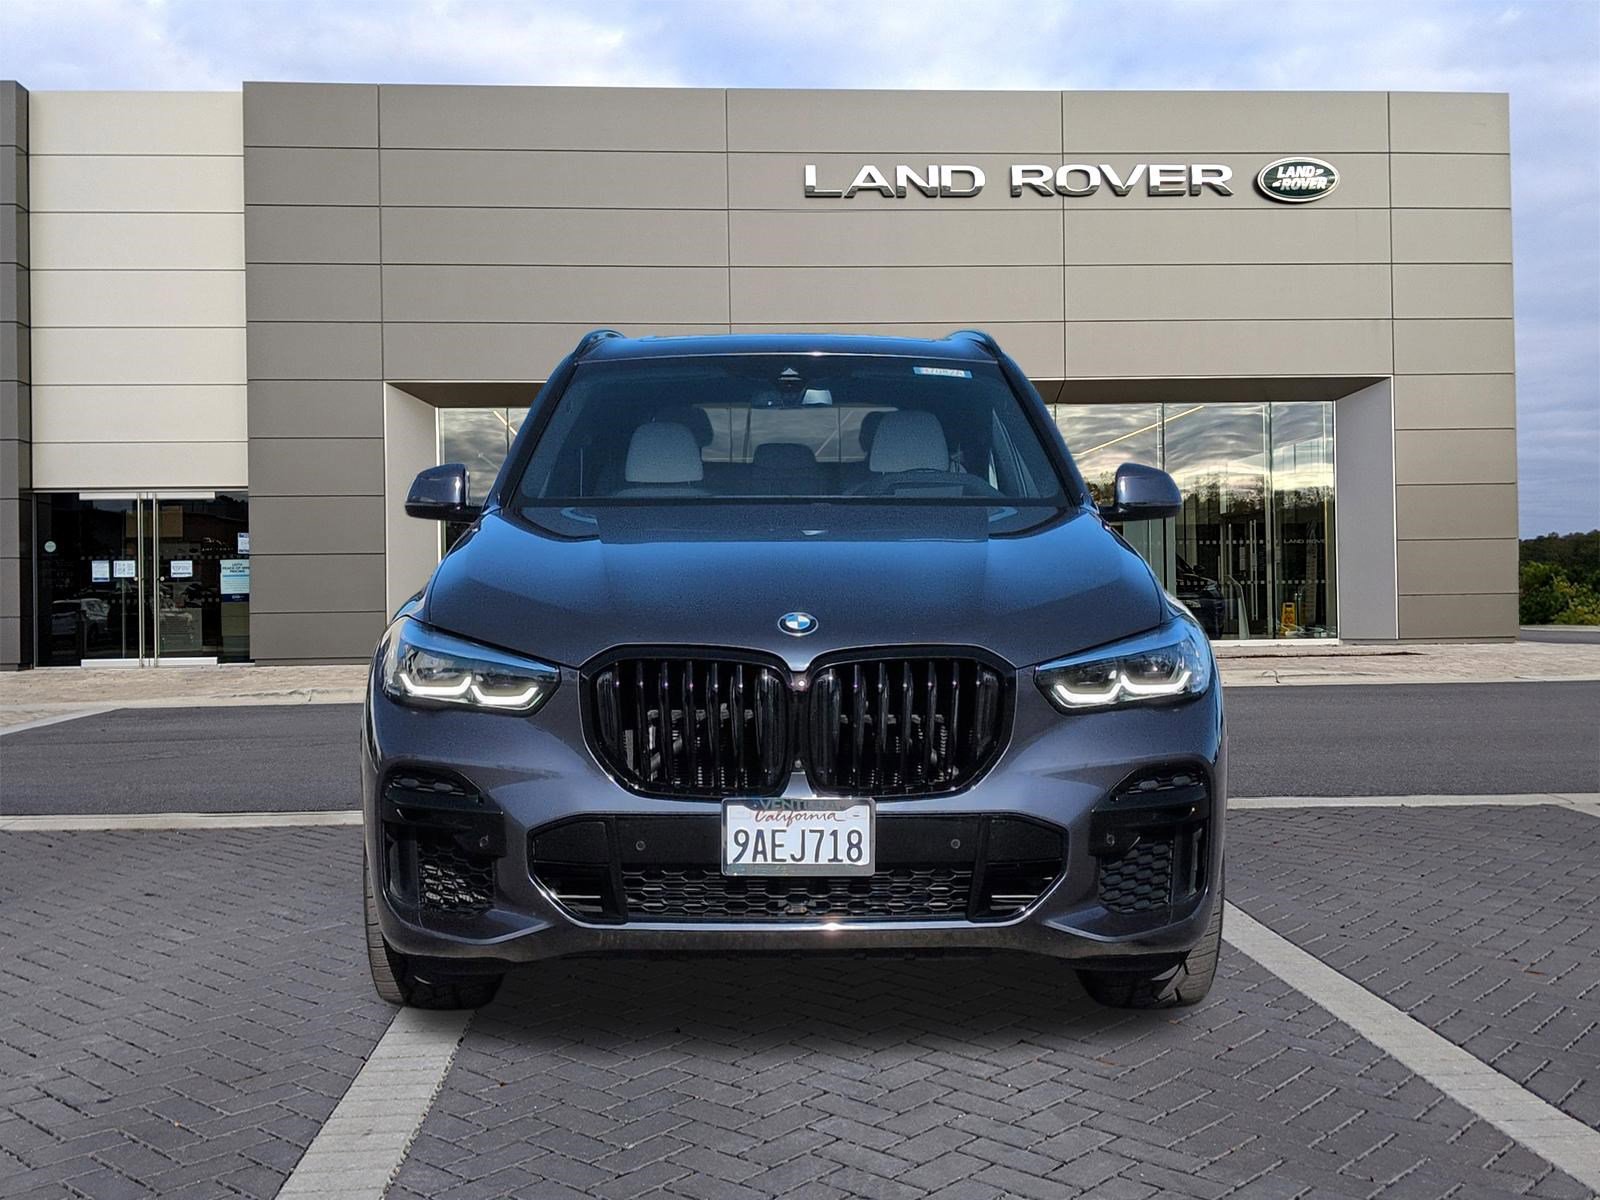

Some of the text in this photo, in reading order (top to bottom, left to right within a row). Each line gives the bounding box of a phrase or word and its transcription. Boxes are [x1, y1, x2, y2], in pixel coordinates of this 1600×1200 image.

[1277, 165, 1316, 178] LAND
[804, 163, 1235, 199] LAND ROVER
[1280, 176, 1328, 191] ROVER
[754, 810, 846, 827] California
[732, 828, 864, 863] 9AEJ718
